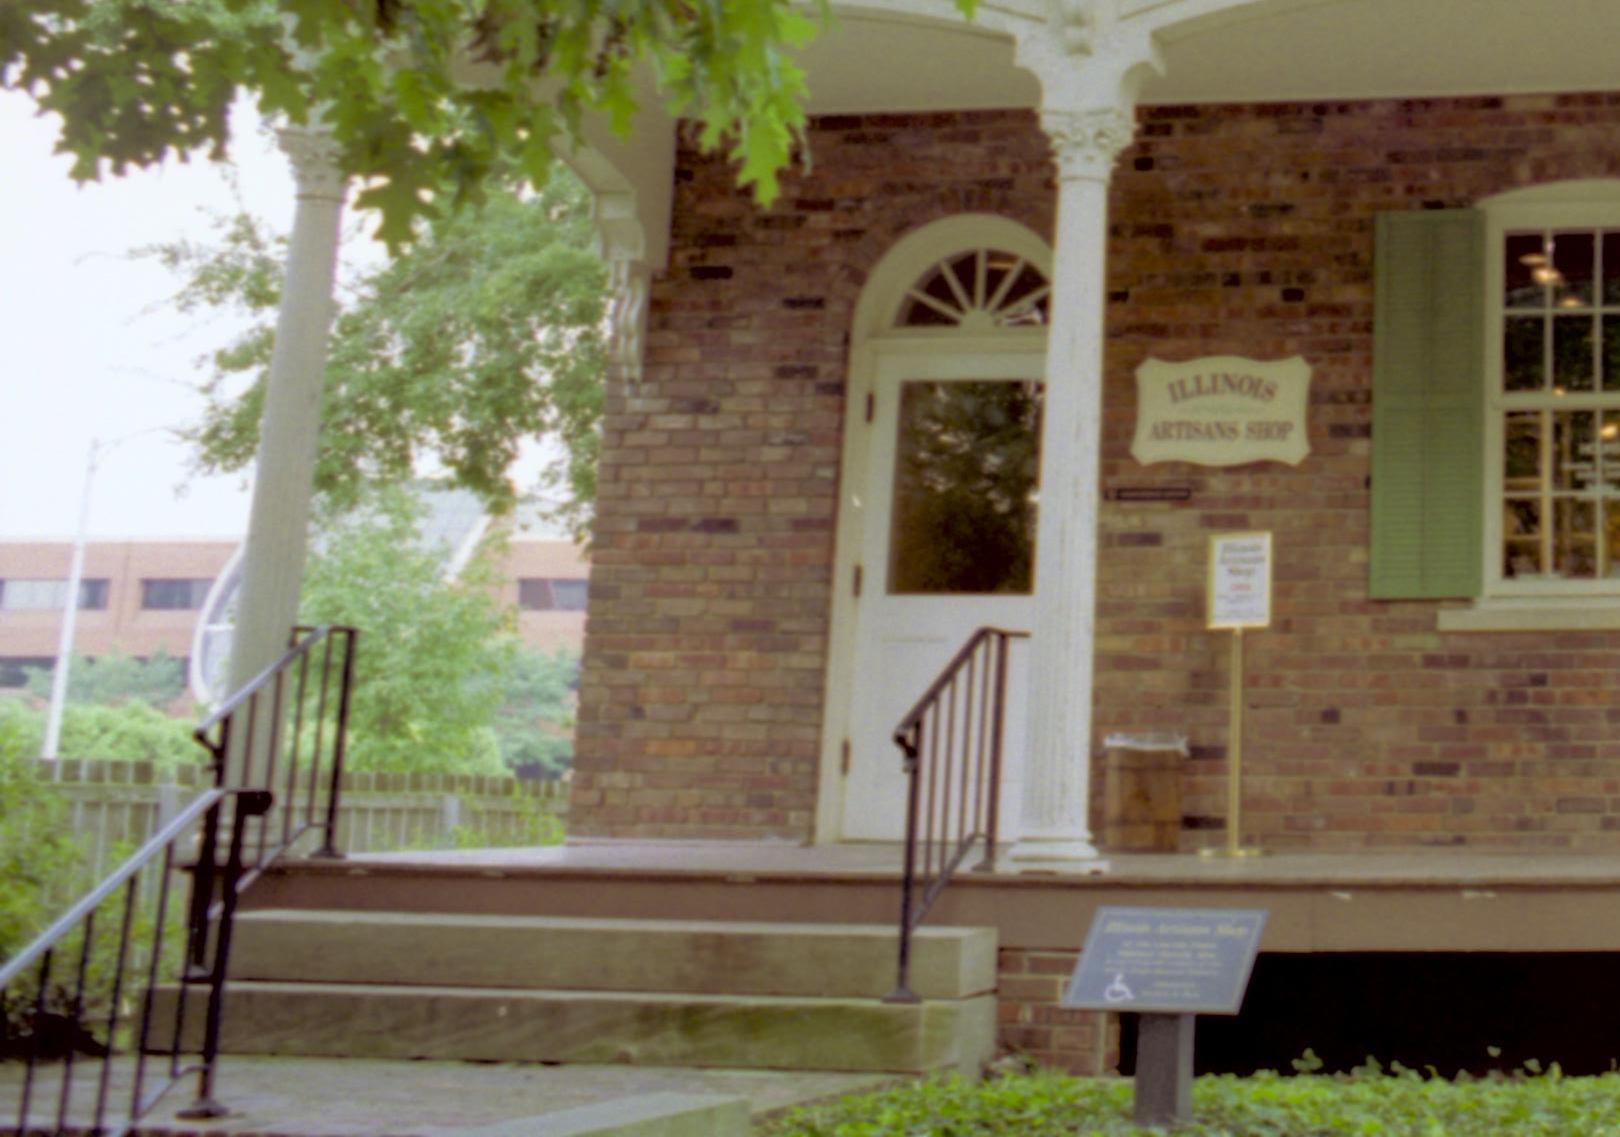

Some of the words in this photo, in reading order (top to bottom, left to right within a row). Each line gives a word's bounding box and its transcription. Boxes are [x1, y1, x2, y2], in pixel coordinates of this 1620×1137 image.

[1167, 372, 1278, 403] ILLINOIS
[1150, 421, 1240, 441] ARTISANS
[1245, 420, 1294, 441] SHOP
